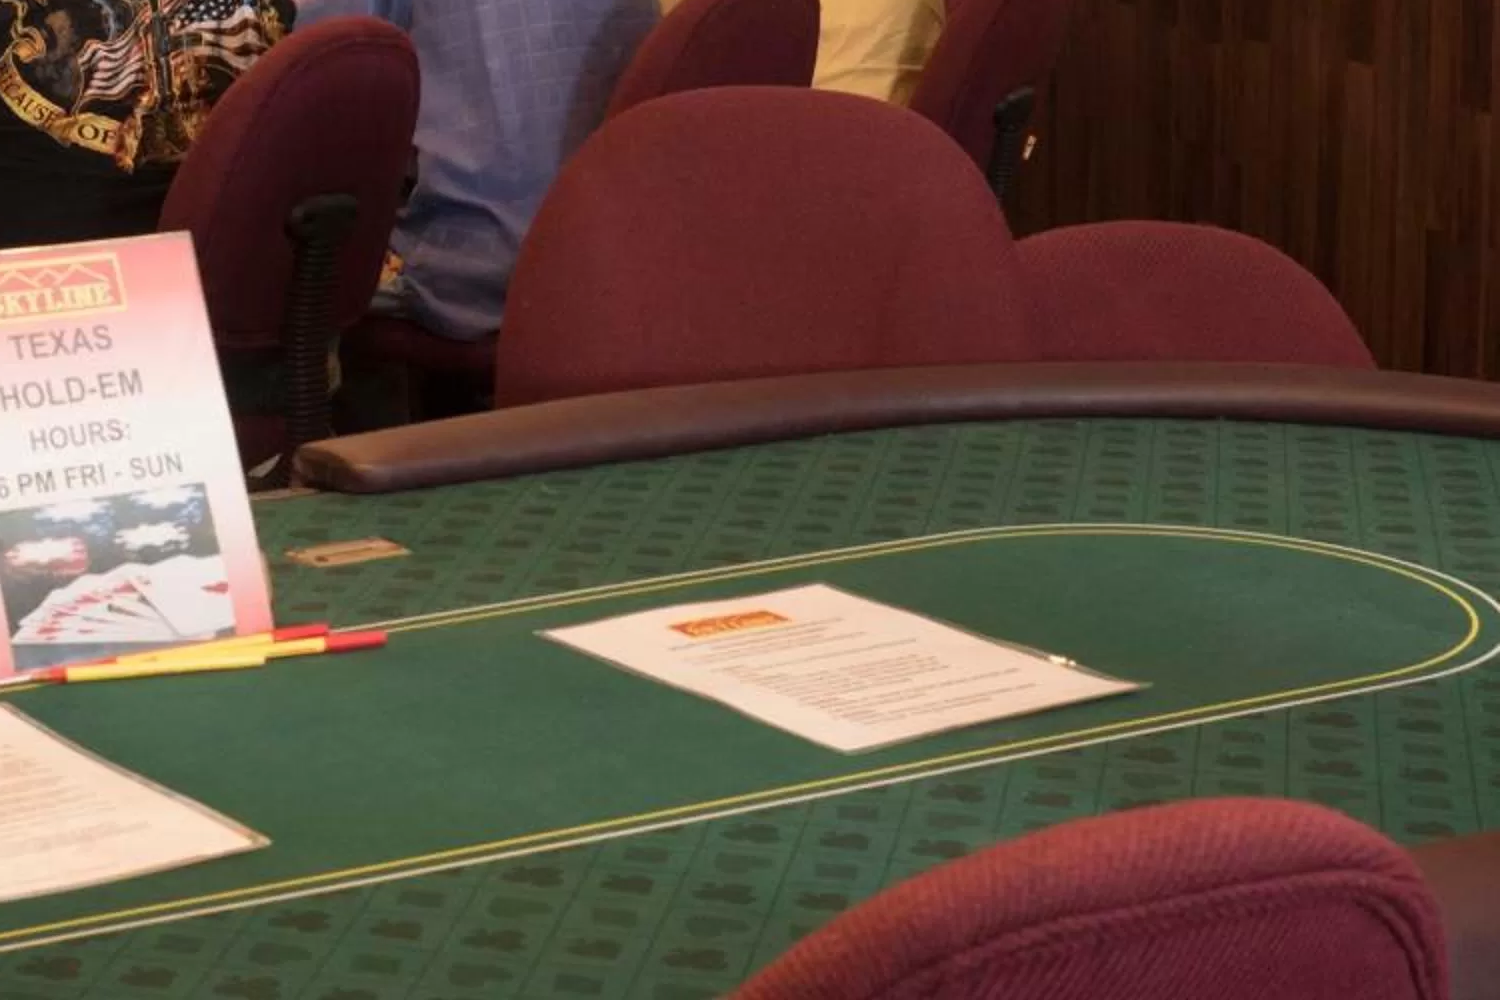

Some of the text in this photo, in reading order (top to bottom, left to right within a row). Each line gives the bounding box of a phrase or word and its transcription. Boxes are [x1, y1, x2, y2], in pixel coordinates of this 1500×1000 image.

[8, 325, 114, 361] TEXAS
[29, 419, 131, 452] HOURS:
[18, 469, 56, 495] PM
[64, 461, 107, 488] FRI
[130, 453, 184, 482] SUN
